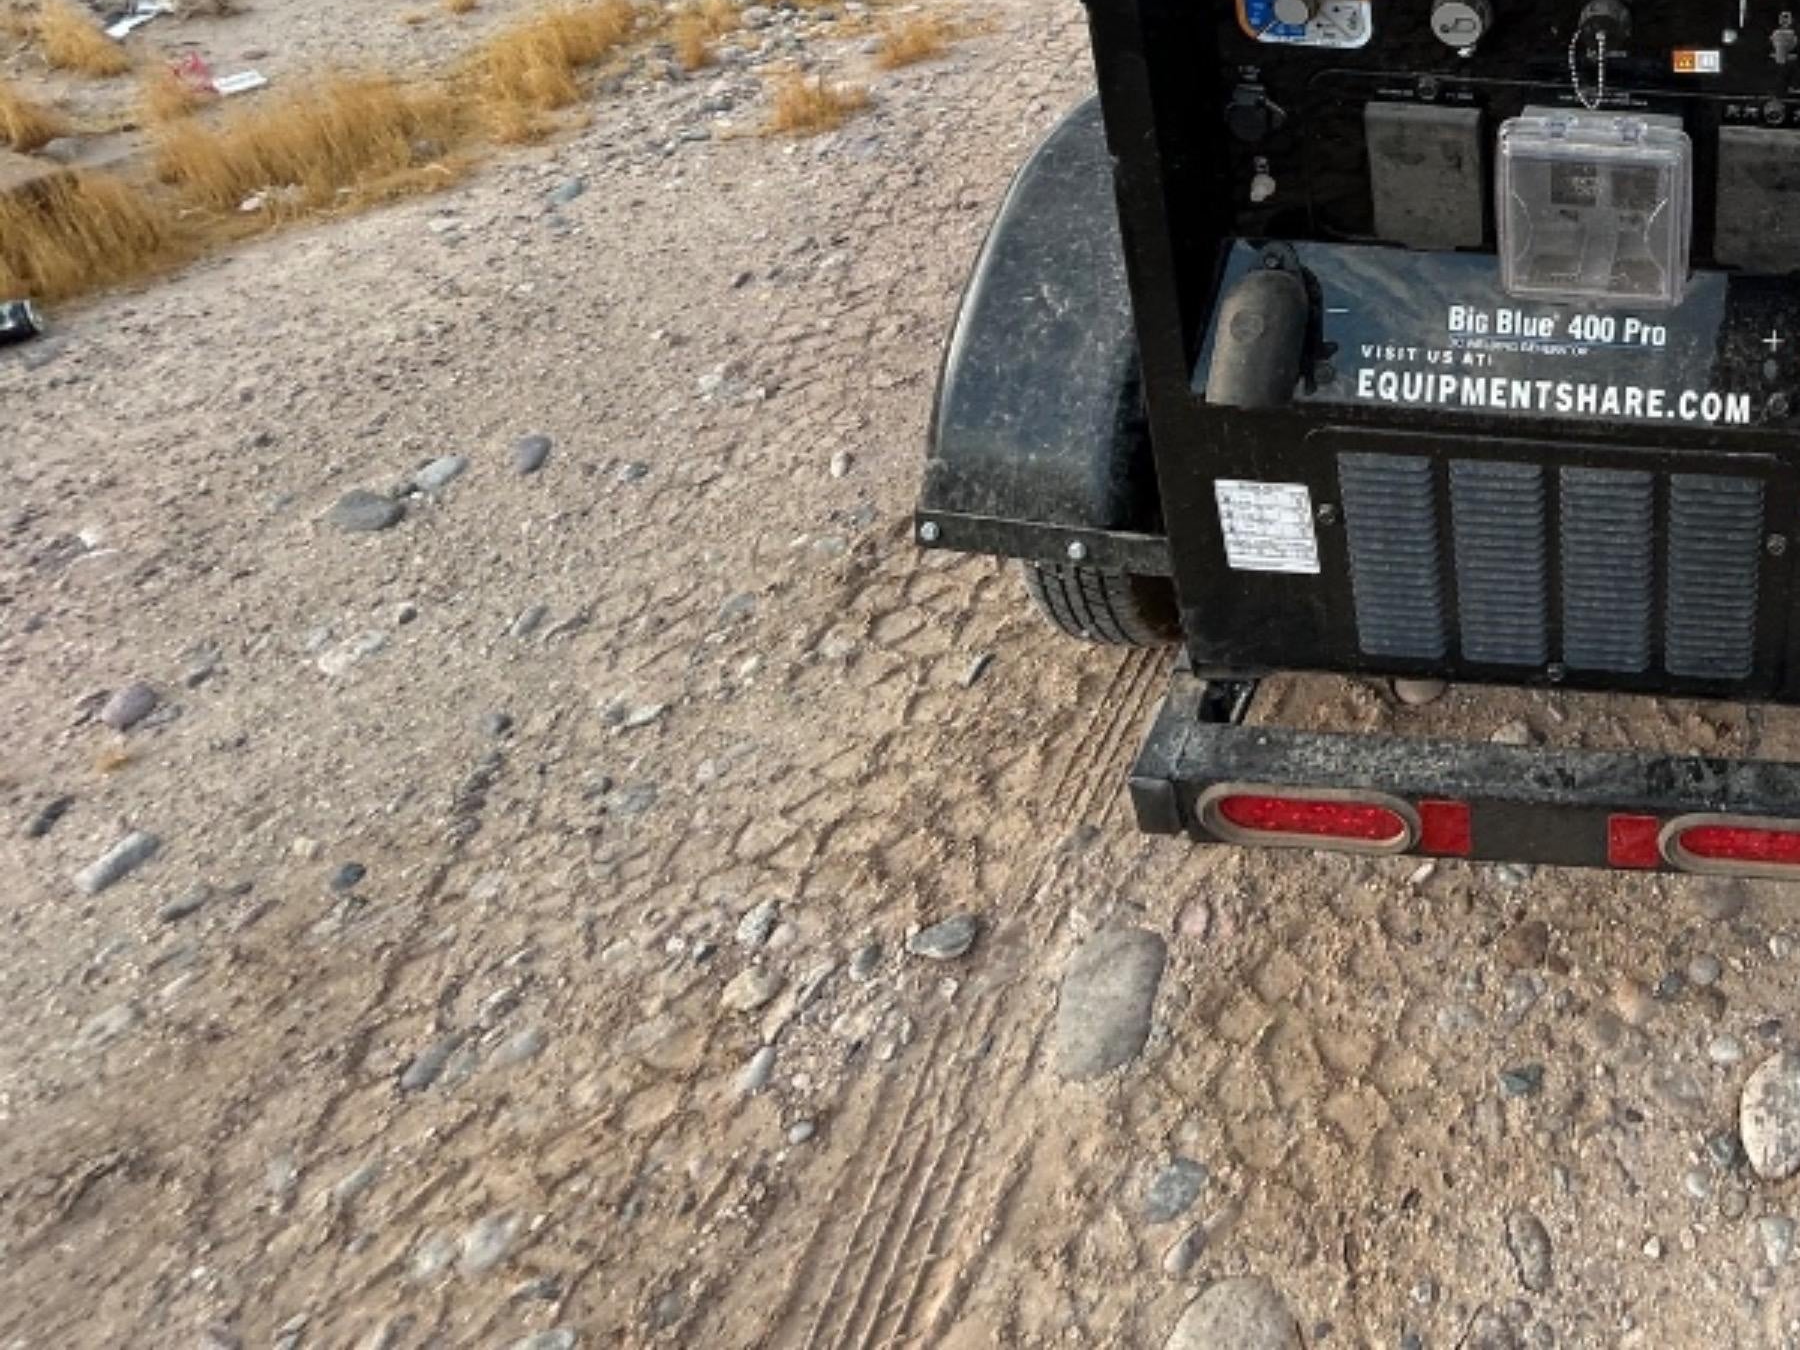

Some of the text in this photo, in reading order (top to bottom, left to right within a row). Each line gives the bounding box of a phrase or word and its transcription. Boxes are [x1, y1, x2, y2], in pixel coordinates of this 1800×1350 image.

[1568, 315, 1616, 343] 400
[1622, 318, 1667, 347] Pro
[1361, 344, 1417, 363] VISIT
[1427, 350, 1454, 365] US
[1356, 367, 1752, 425] EQUIPMENTSHARE.COM
